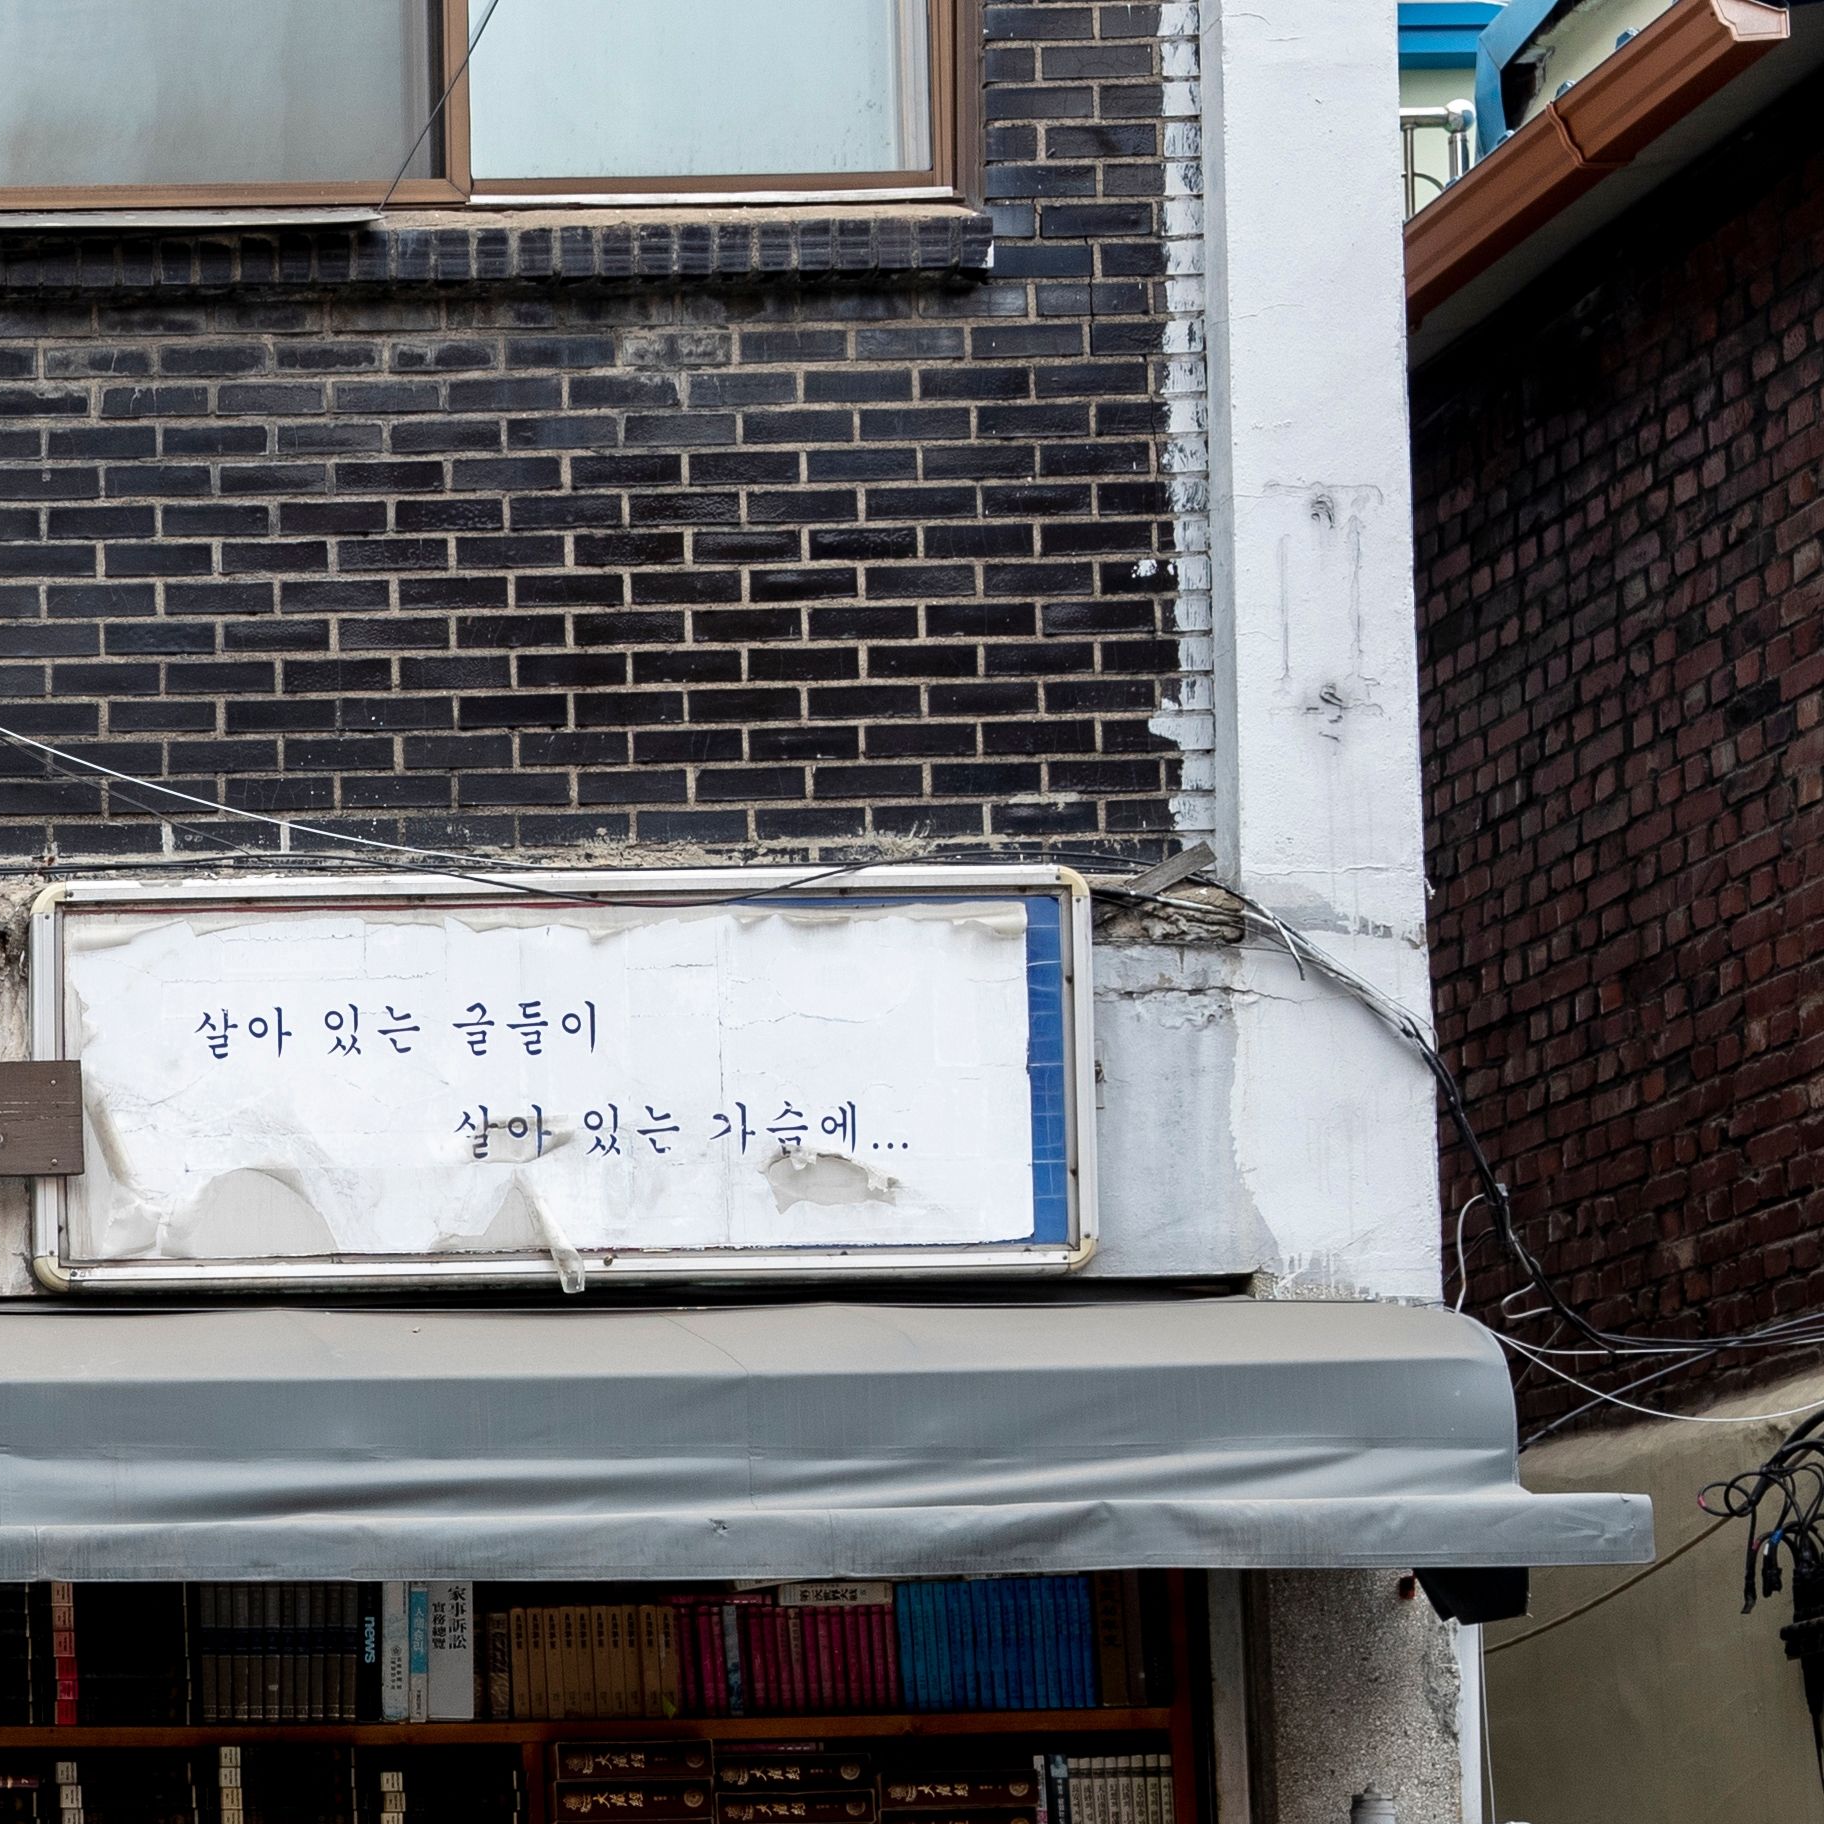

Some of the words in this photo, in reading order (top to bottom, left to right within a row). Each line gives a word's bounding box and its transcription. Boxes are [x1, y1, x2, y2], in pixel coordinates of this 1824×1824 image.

[194, 1003, 292, 1060] 살아
[324, 1003, 420, 1057] 있는
[452, 1000, 598, 1057] 글들이
[454, 1101, 552, 1160] 살아
[584, 1101, 681, 1157] 있는
[364, 1617, 375, 1665] news
